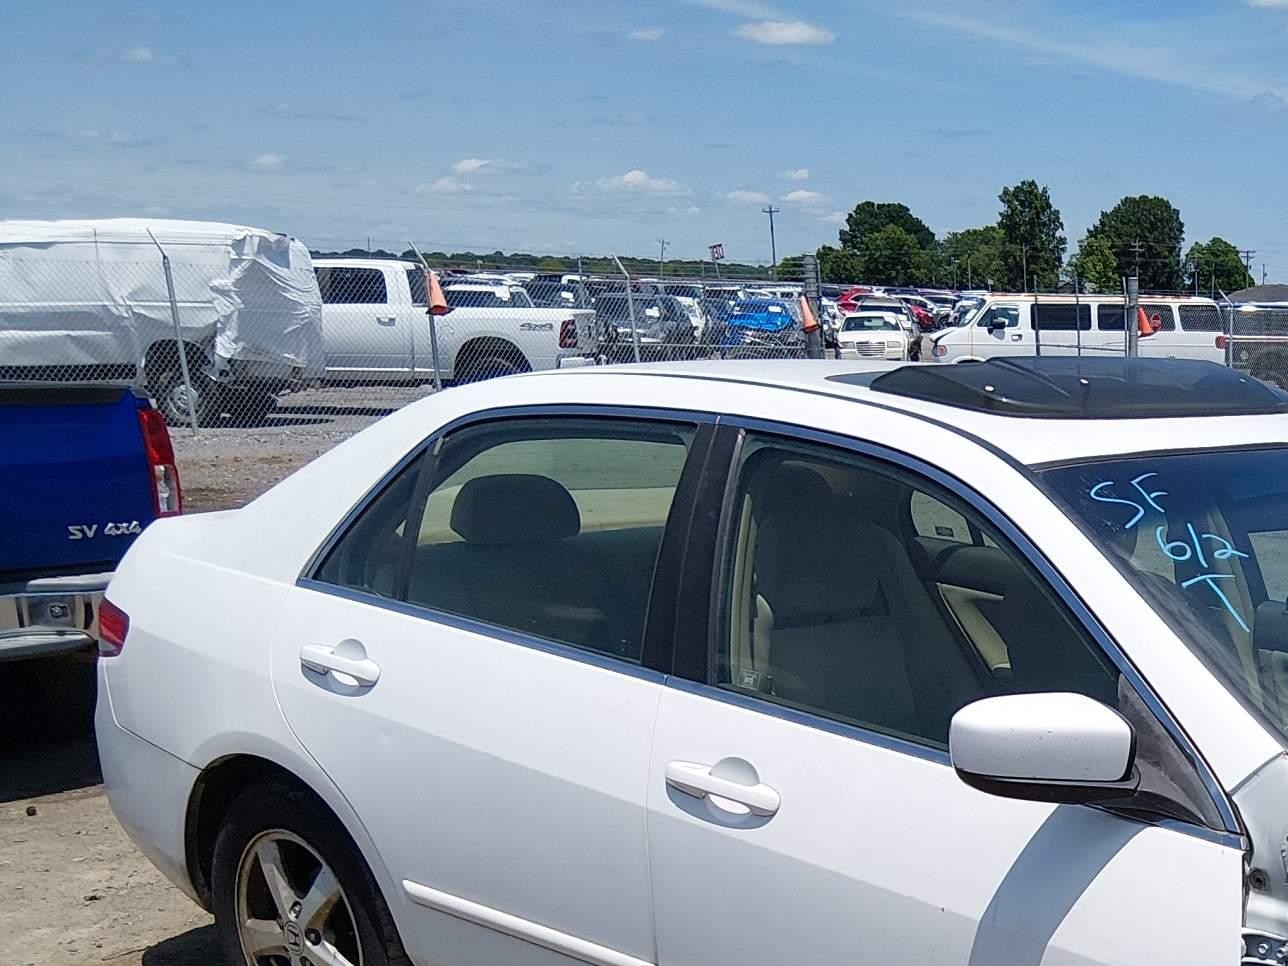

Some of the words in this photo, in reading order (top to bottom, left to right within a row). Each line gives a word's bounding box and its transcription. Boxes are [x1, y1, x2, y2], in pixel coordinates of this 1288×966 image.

[1089, 466, 1169, 529] SF
[68, 524, 98, 539] SV
[1181, 573, 1250, 633] T
